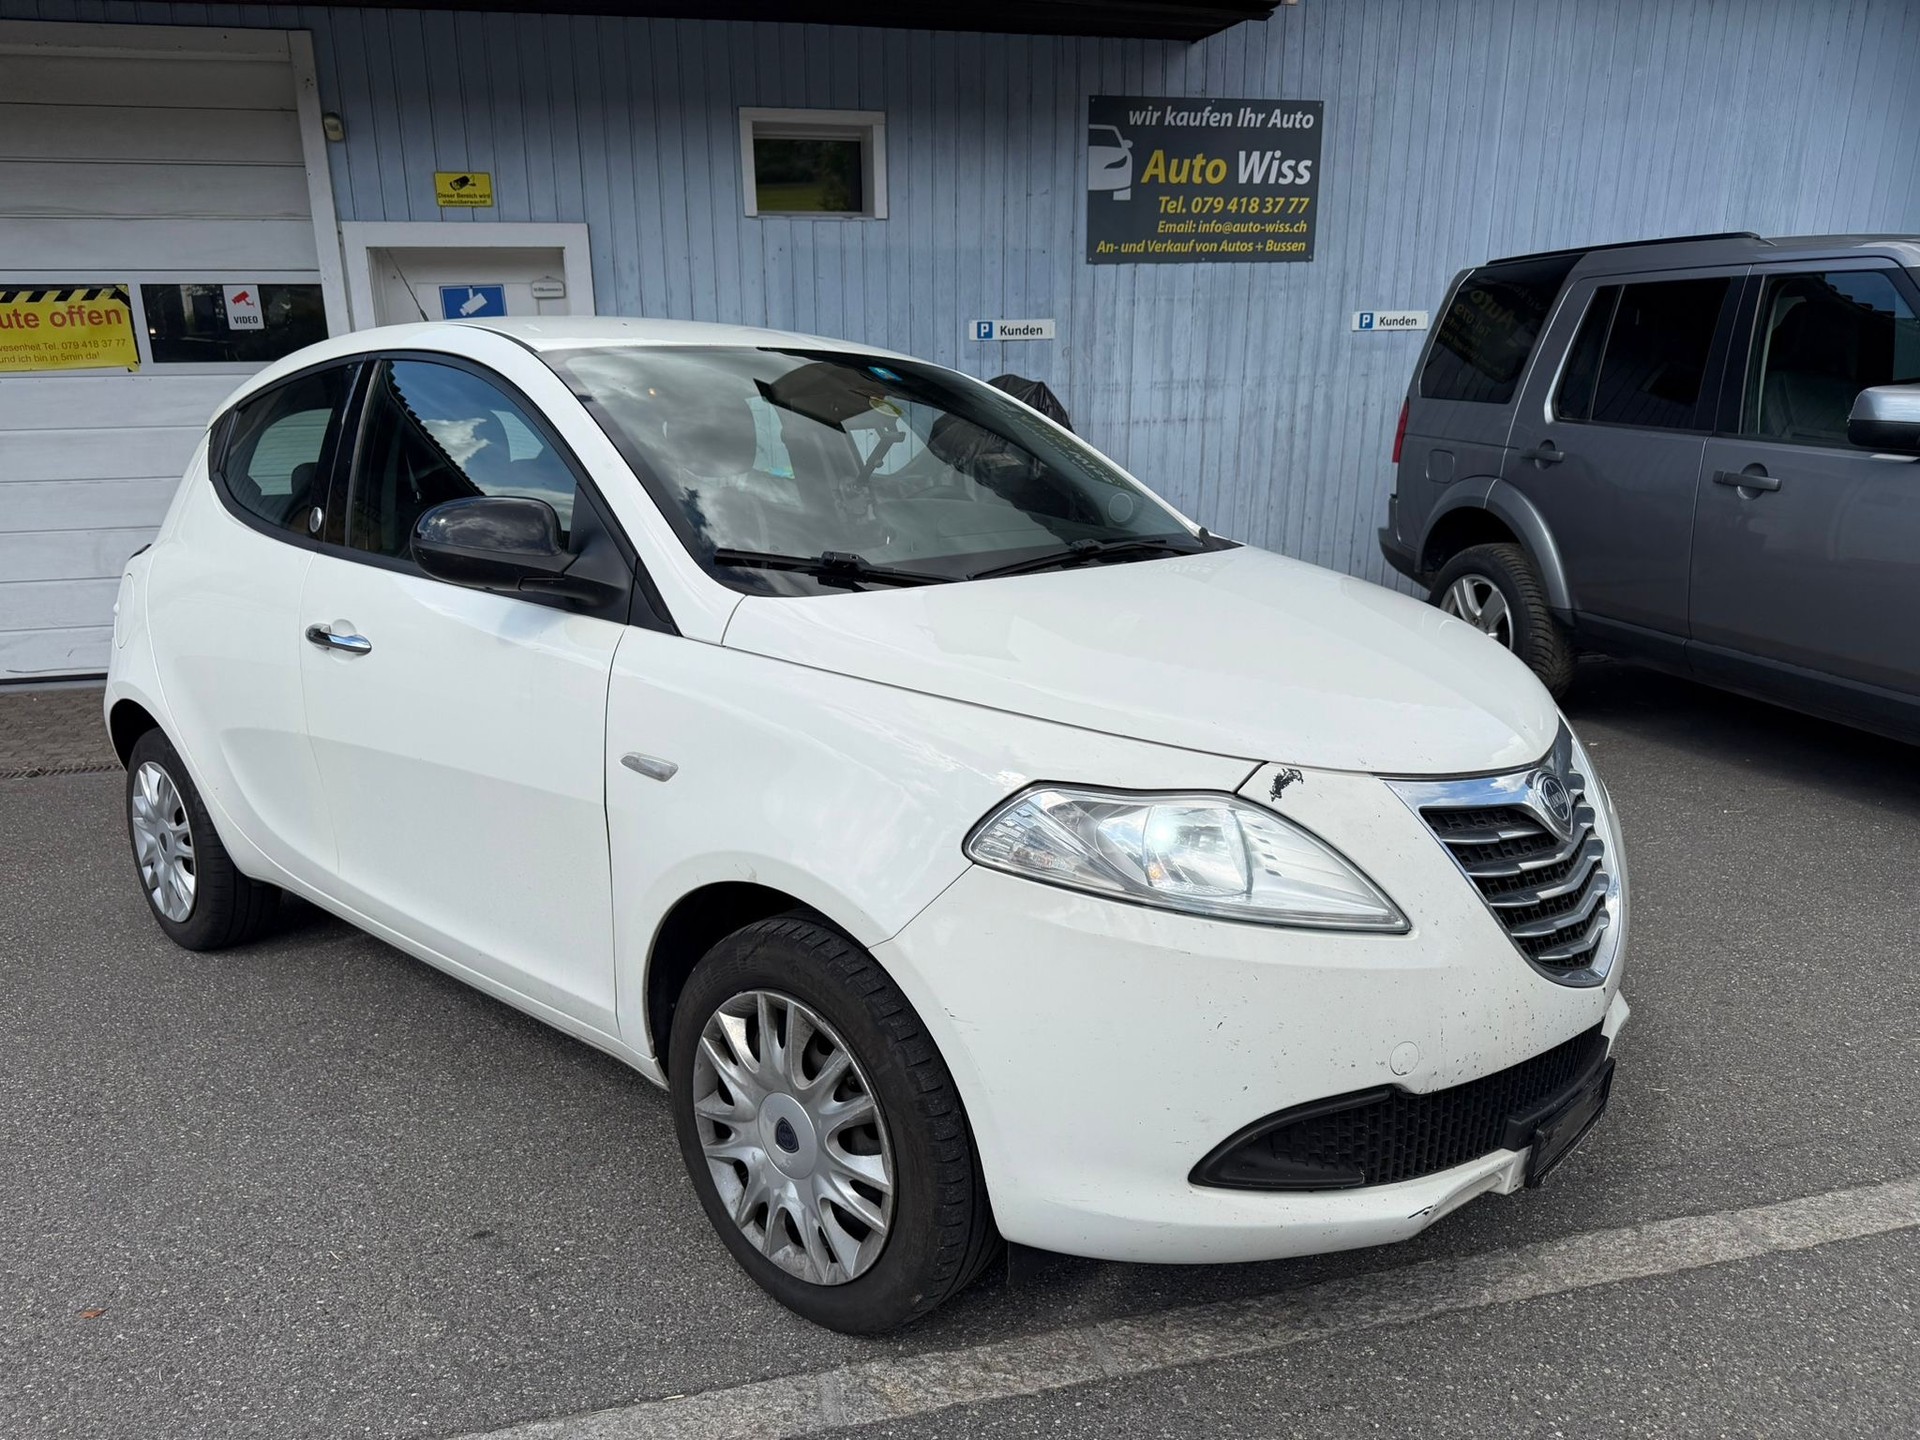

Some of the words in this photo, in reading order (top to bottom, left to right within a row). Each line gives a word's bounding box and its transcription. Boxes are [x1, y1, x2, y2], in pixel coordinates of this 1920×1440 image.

[1129, 106, 1161, 126] wir
[1164, 106, 1232, 128] kaufen
[1237, 107, 1265, 128] Ihr
[1267, 108, 1314, 129] Auto
[1140, 149, 1227, 185] Auto
[1238, 150, 1313, 185] Wiss
[1158, 196, 1187, 214] Tel.
[1191, 197, 1224, 214] 079
[1227, 197, 1260, 214] 418
[1262, 197, 1286, 214] 37
[1287, 197, 1310, 214] 77
[1157, 220, 1197, 233] Email:
[1198, 220, 1307, 235] info@auto-wiss.ch
[1097, 240, 1119, 253] An-
[1121, 240, 1148, 253] und
[1149, 239, 1195, 253] Verkauf
[1195, 242, 1218, 253] von
[1219, 240, 1254, 253] Autos
[1255, 243, 1263, 252] +
[1265, 240, 1306, 252] Bussen
[49, 305, 122, 328] offen
[233, 315, 259, 324] VIDEO
[1361, 314, 1371, 328] P
[1379, 315, 1417, 327] Kunden
[980, 323, 990, 337] P
[1000, 324, 1043, 336] Kunden
[0, 342, 41, 352] esenheit
[61, 340, 80, 350] 079
[81, 339, 99, 349] 418
[101, 339, 113, 348] 37
[115, 338, 126, 347] 77
[18, 354, 31, 363] ich
[33, 353, 48, 362] bin
[50, 354, 59, 362] in
[60, 352, 83, 361] 5min
